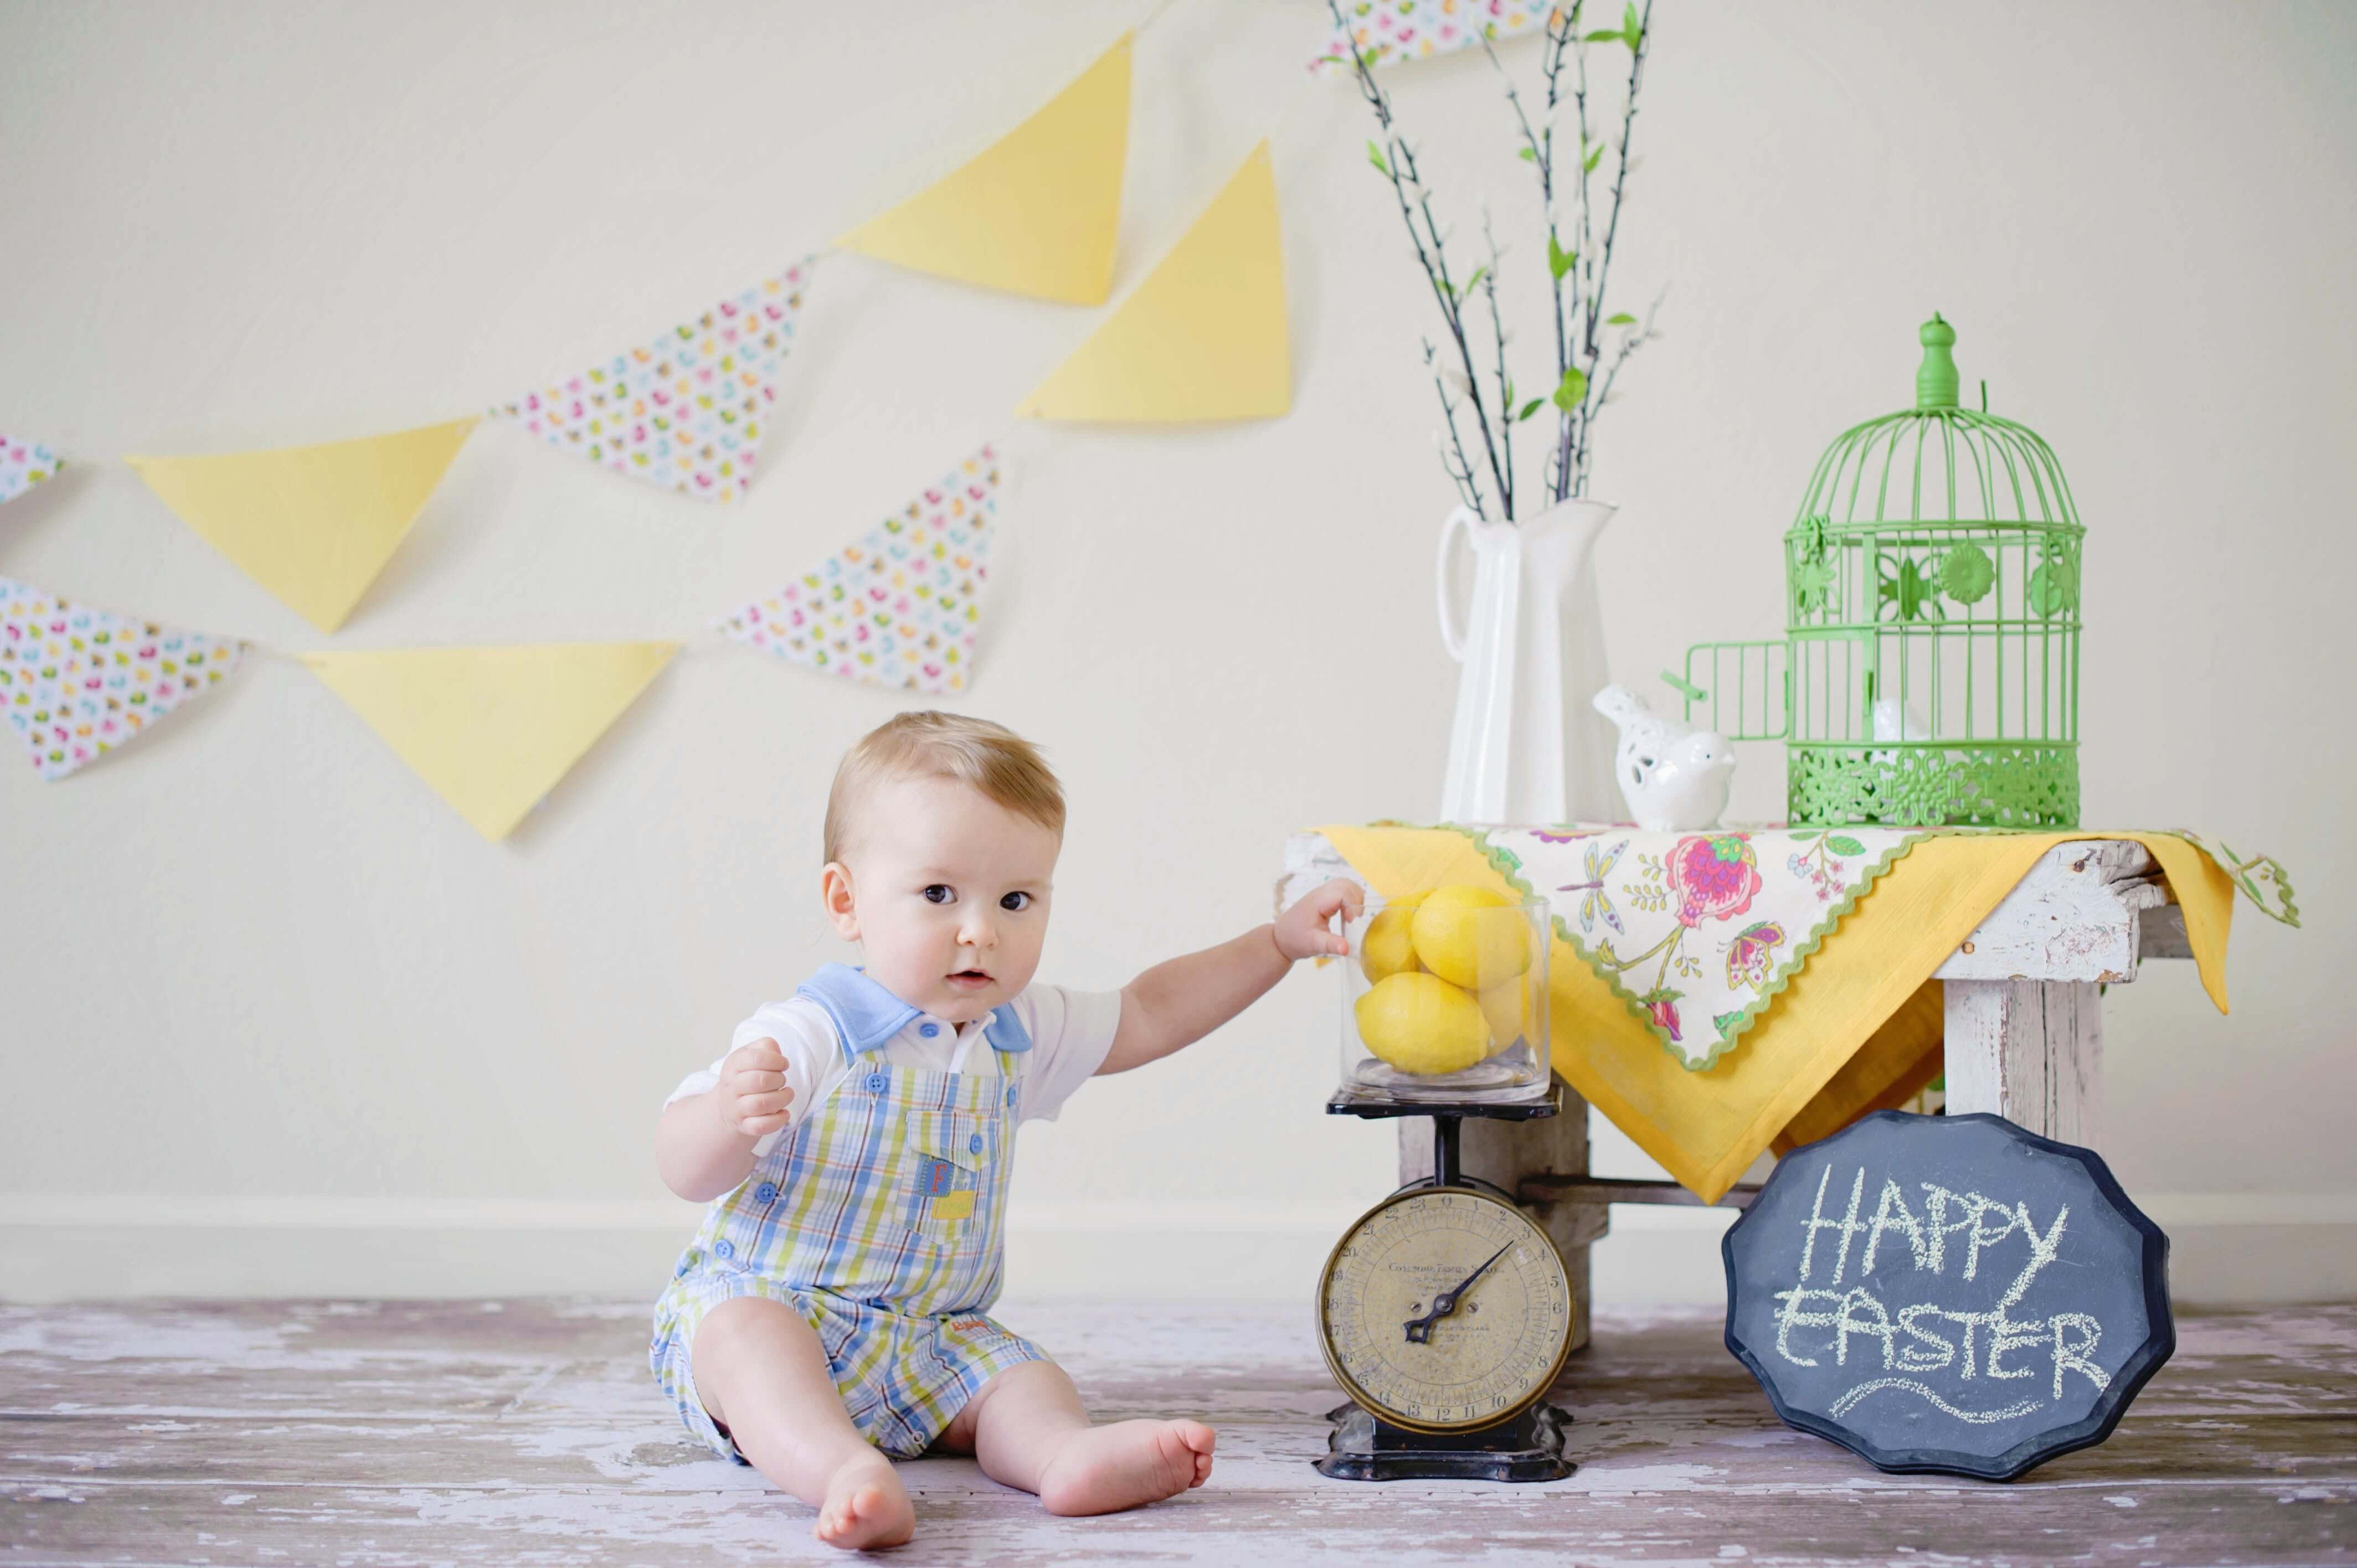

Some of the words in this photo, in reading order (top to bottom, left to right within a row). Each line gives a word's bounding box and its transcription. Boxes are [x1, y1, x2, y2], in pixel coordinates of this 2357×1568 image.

[931, 1163, 948, 1193] F
[1499, 1209, 1507, 1221] 2
[1799, 1163, 2070, 1311] HAPPY
[1342, 1246, 1356, 1257] 20
[1550, 1276, 1558, 1288] 5
[1552, 1302, 1562, 1314] 6
[1550, 1329, 1558, 1342] 7
[1774, 1283, 2111, 1400] EASTER
[1537, 1355, 1547, 1368] 8
[1519, 1378, 1529, 1389] 9
[1491, 1395, 1507, 1408] 10
[1436, 1407, 1450, 1421] 12
